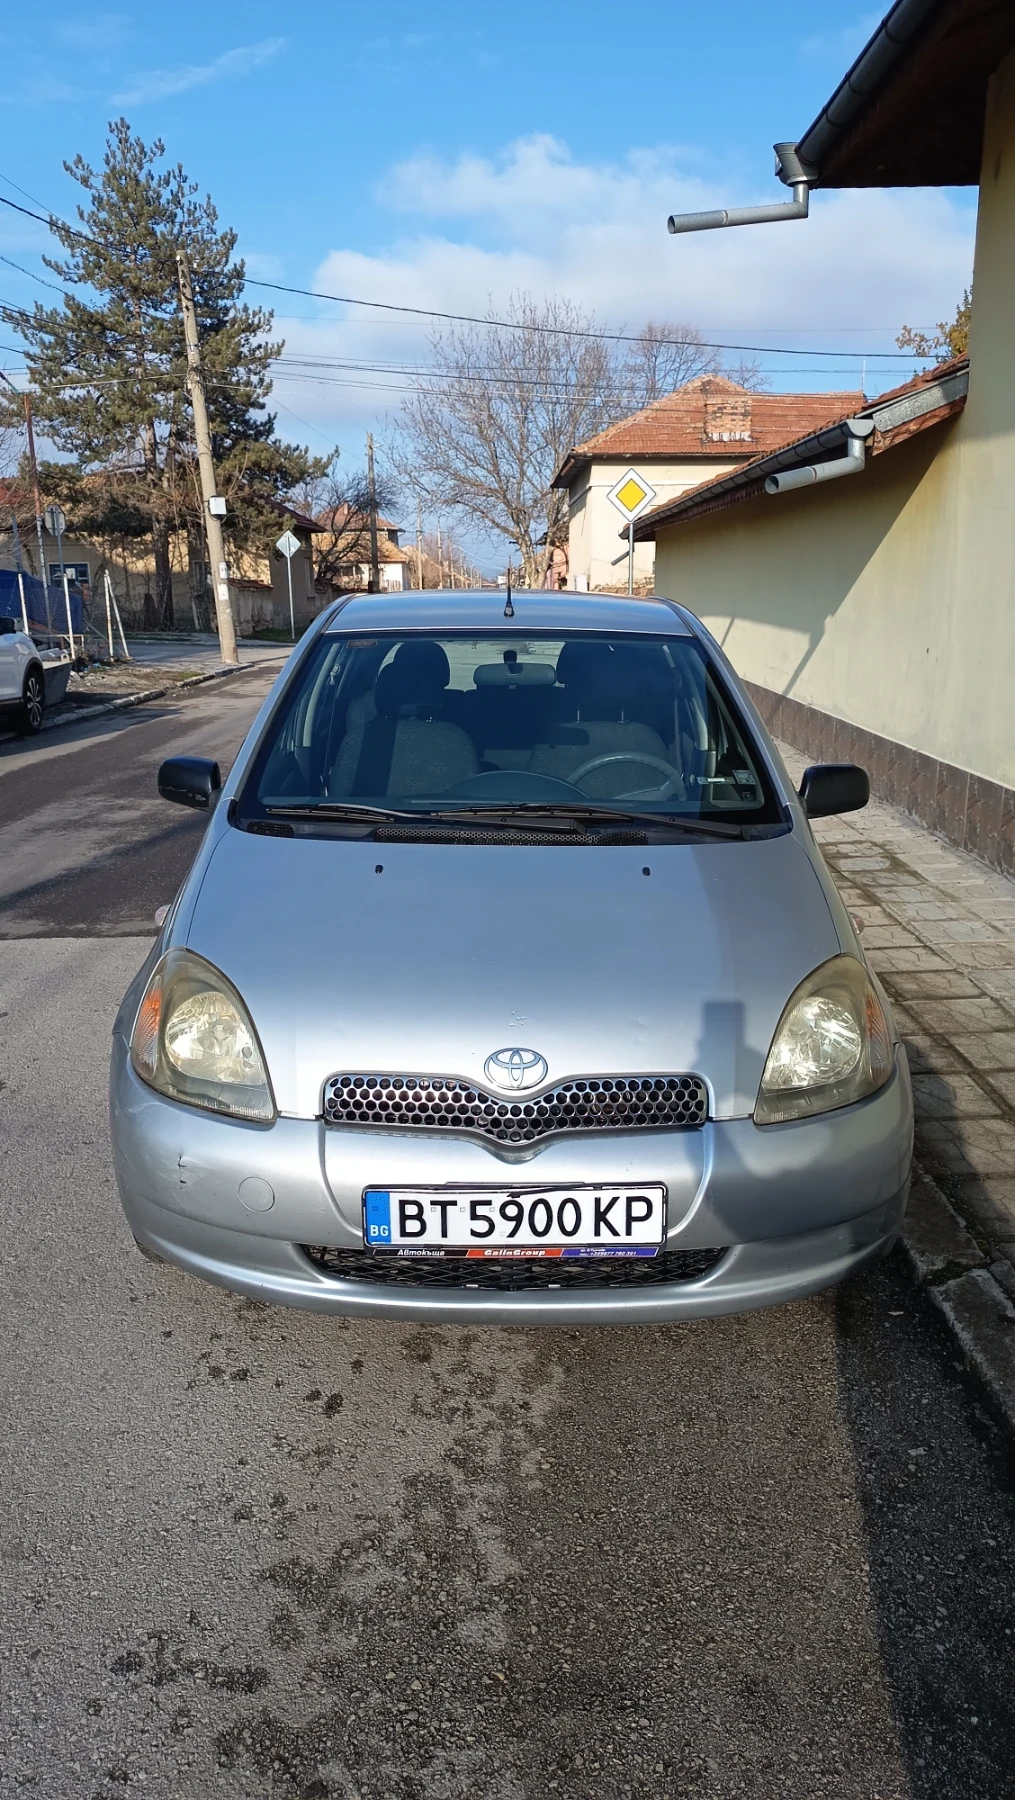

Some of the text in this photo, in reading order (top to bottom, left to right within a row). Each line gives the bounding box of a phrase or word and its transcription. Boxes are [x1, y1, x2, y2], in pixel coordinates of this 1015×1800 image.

[399, 1195, 653, 1239] BT 5900 KP
[370, 1224, 389, 1237] BG
[397, 1249, 446, 1257] Автокъща
[484, 1249, 546, 1257] GalinGroup
